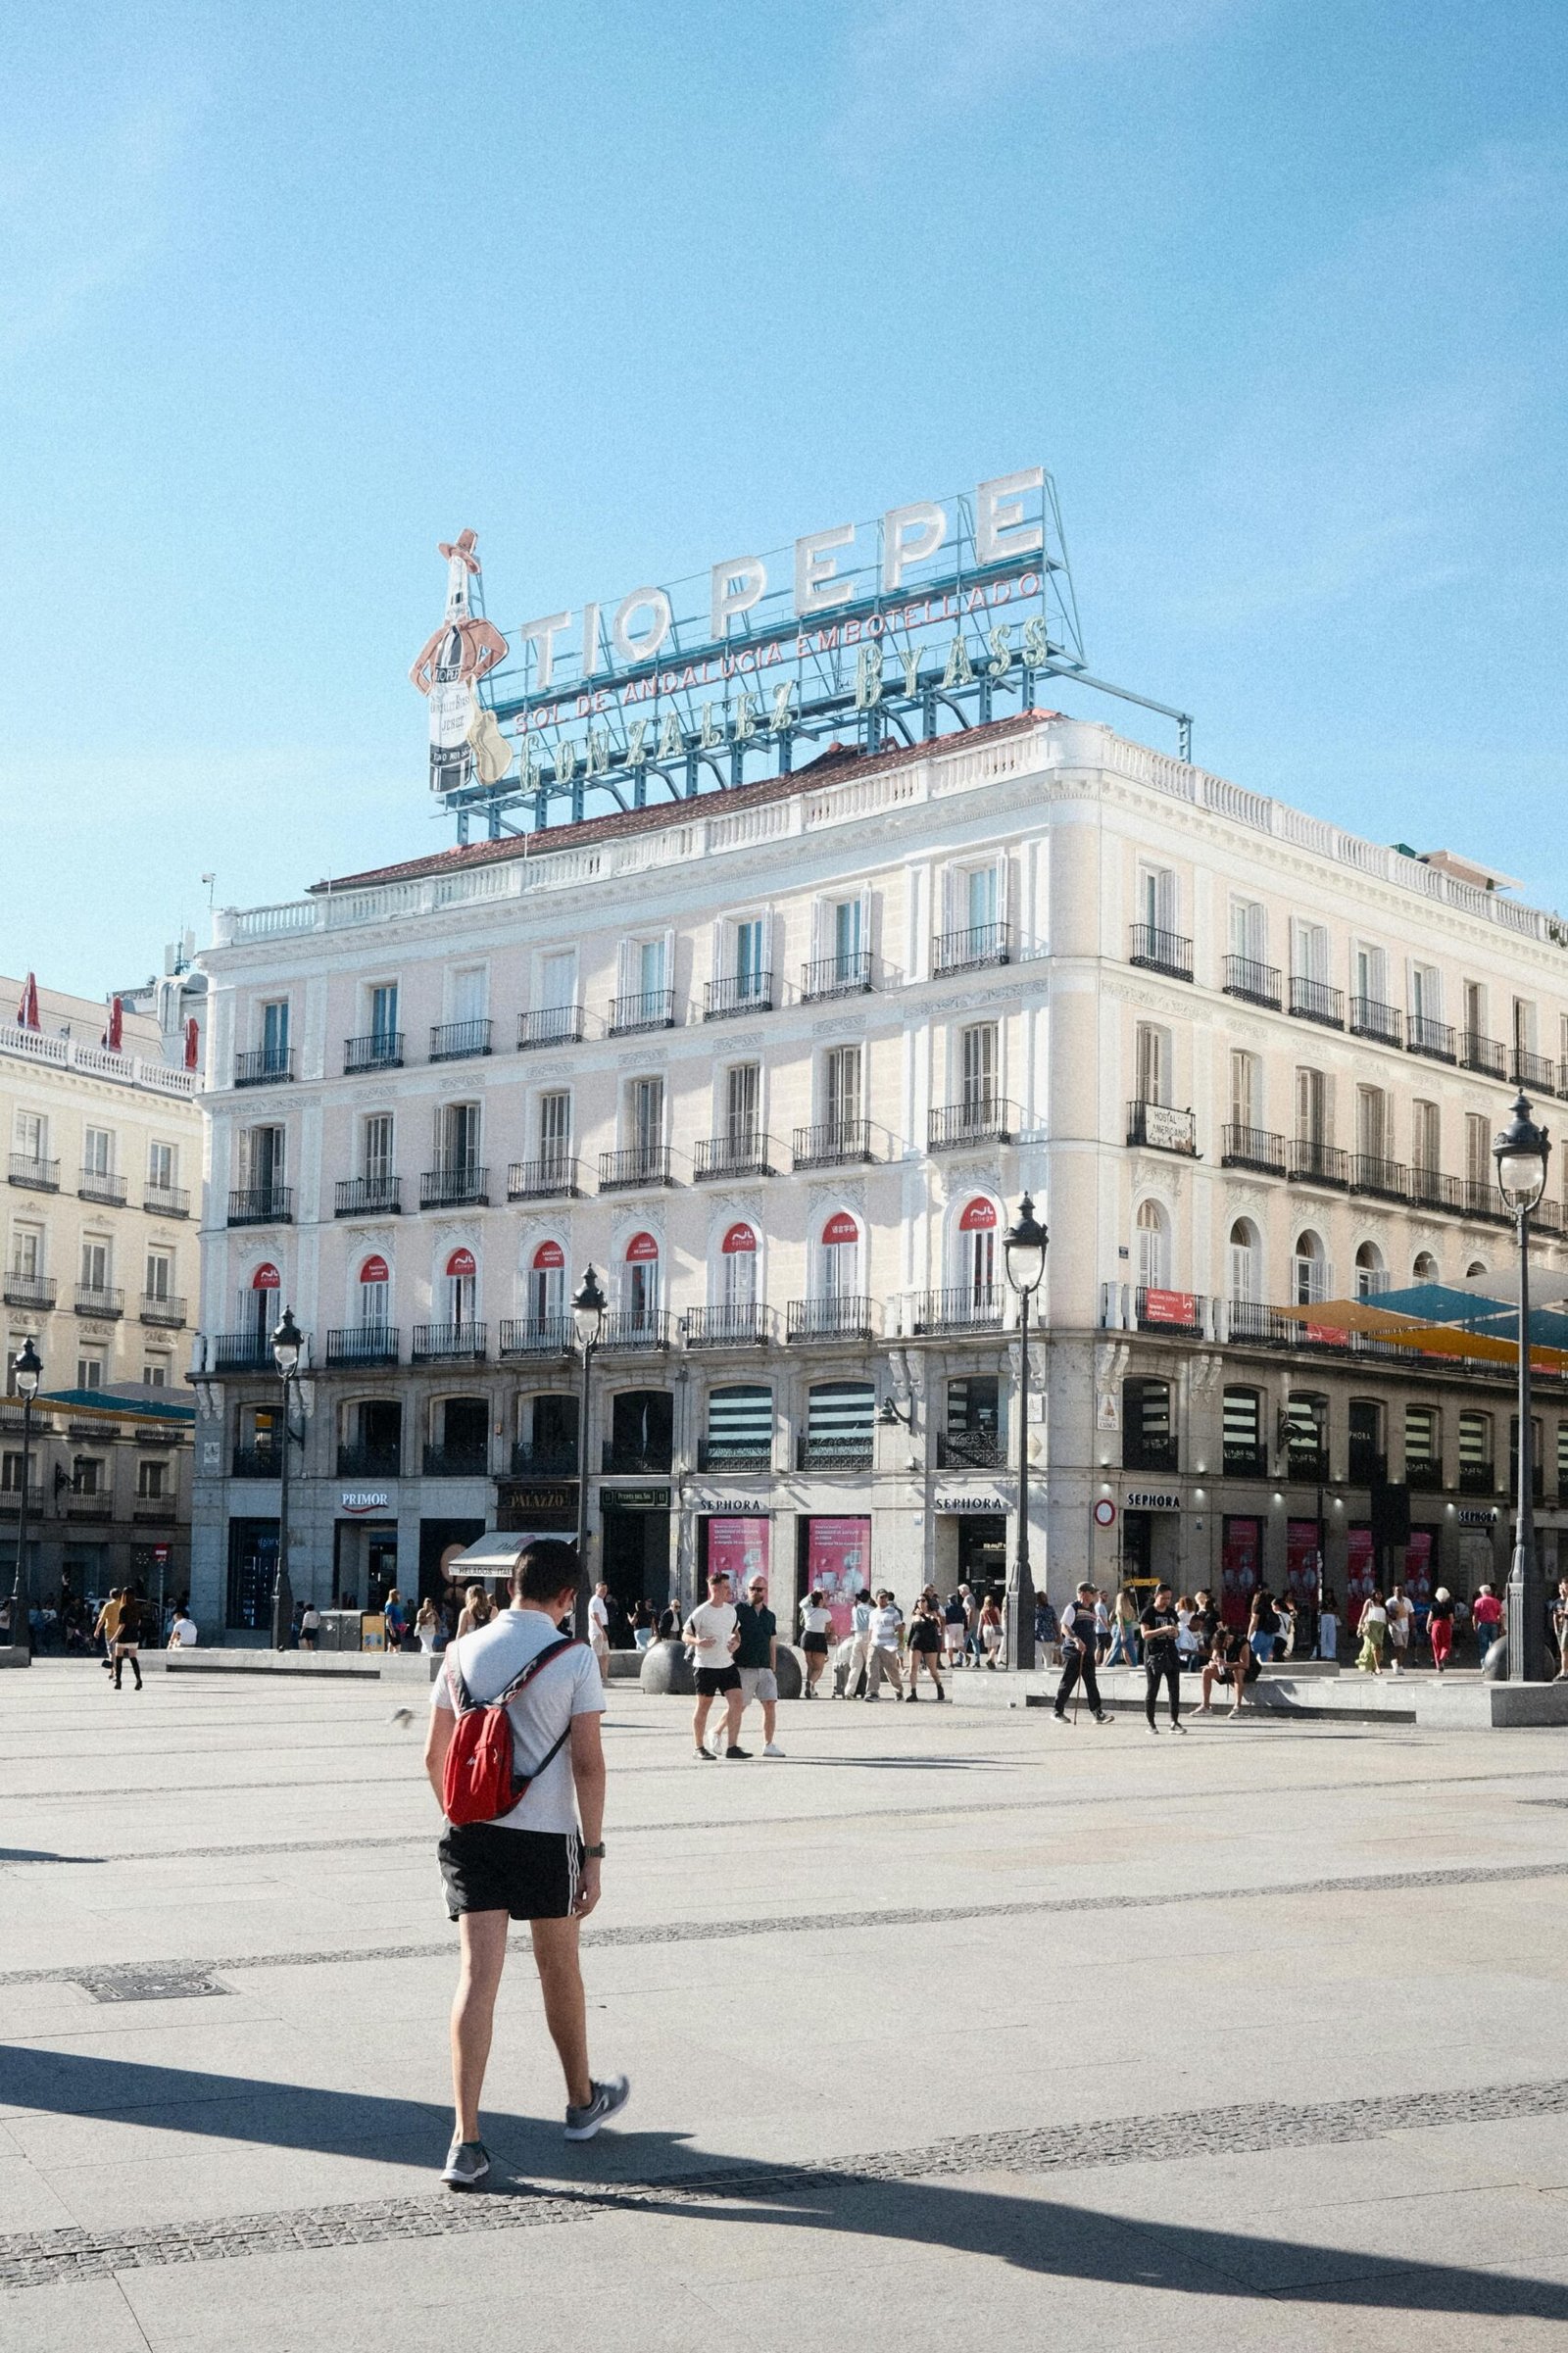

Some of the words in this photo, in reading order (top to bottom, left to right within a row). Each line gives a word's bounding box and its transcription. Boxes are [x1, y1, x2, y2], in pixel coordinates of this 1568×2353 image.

[521, 586, 672, 689] TIO
[710, 466, 1044, 640] PEPE
[514, 703, 569, 734] SOL
[577, 689, 612, 717] DE
[623, 642, 783, 706] ANDALUCIA
[796, 572, 1041, 658] EMBOTELLADO
[519, 679, 795, 793] GONZALEZ
[855, 614, 1048, 711] BYASS
[342, 1494, 389, 1505] PRIMOR
[701, 1499, 760, 1510] SEPHORA
[936, 1497, 1002, 1509] SEPHORA
[1128, 1494, 1180, 1507] SEPHORA
[1459, 1511, 1497, 1522] SEPHORA
